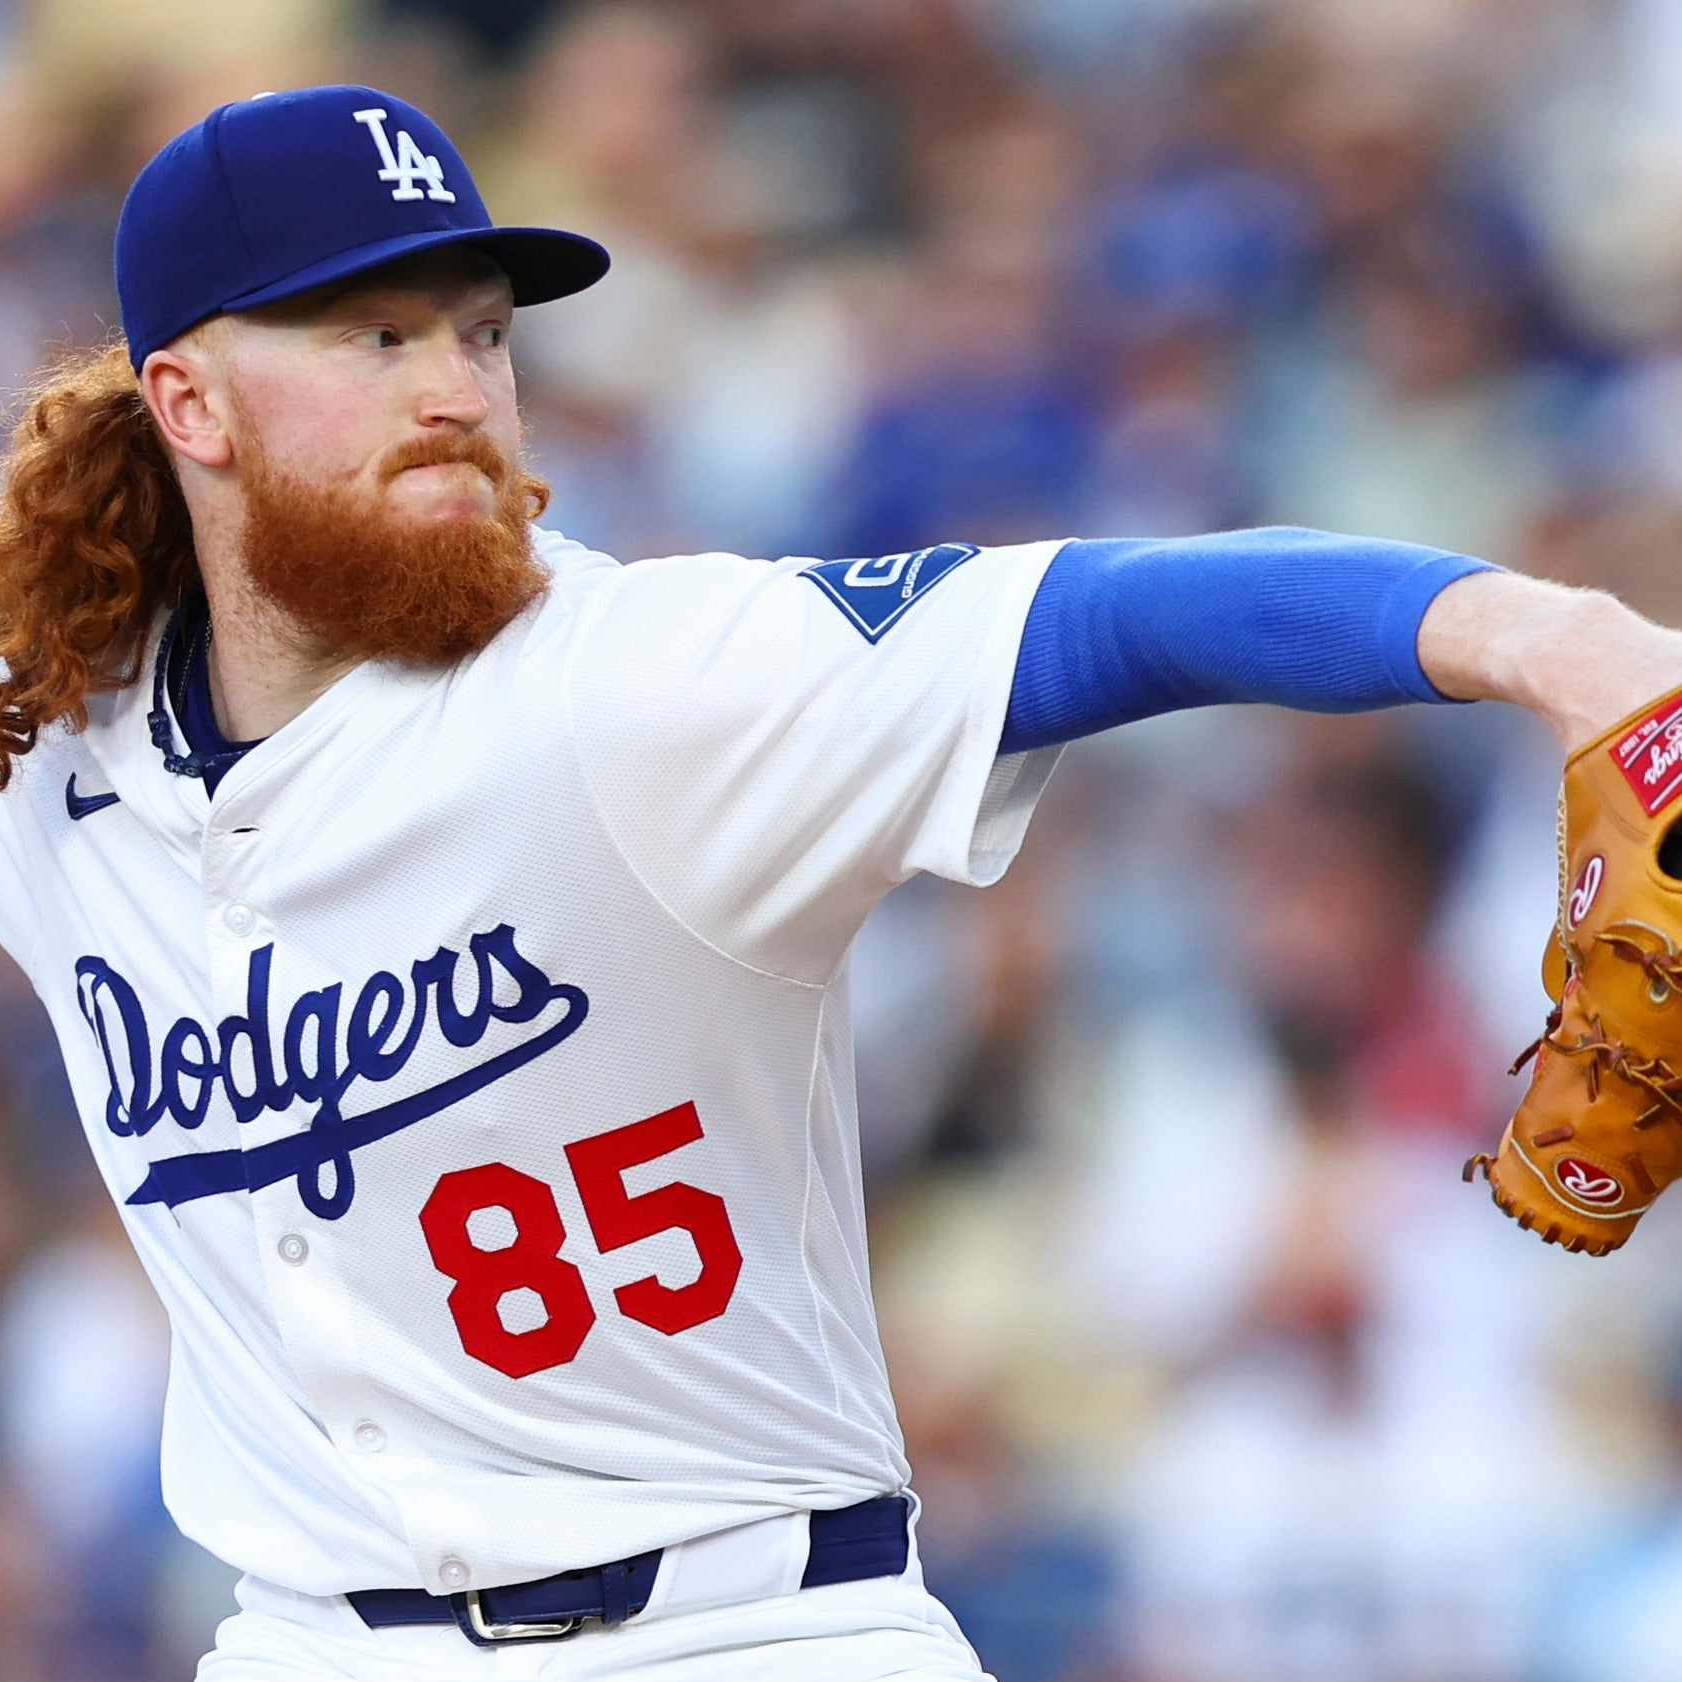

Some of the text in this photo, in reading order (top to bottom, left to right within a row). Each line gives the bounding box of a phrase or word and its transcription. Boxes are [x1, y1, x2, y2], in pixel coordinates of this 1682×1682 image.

[353, 108, 456, 204] LA
[75, 922, 589, 1220] Dodgers
[419, 1100, 744, 1379] 85
